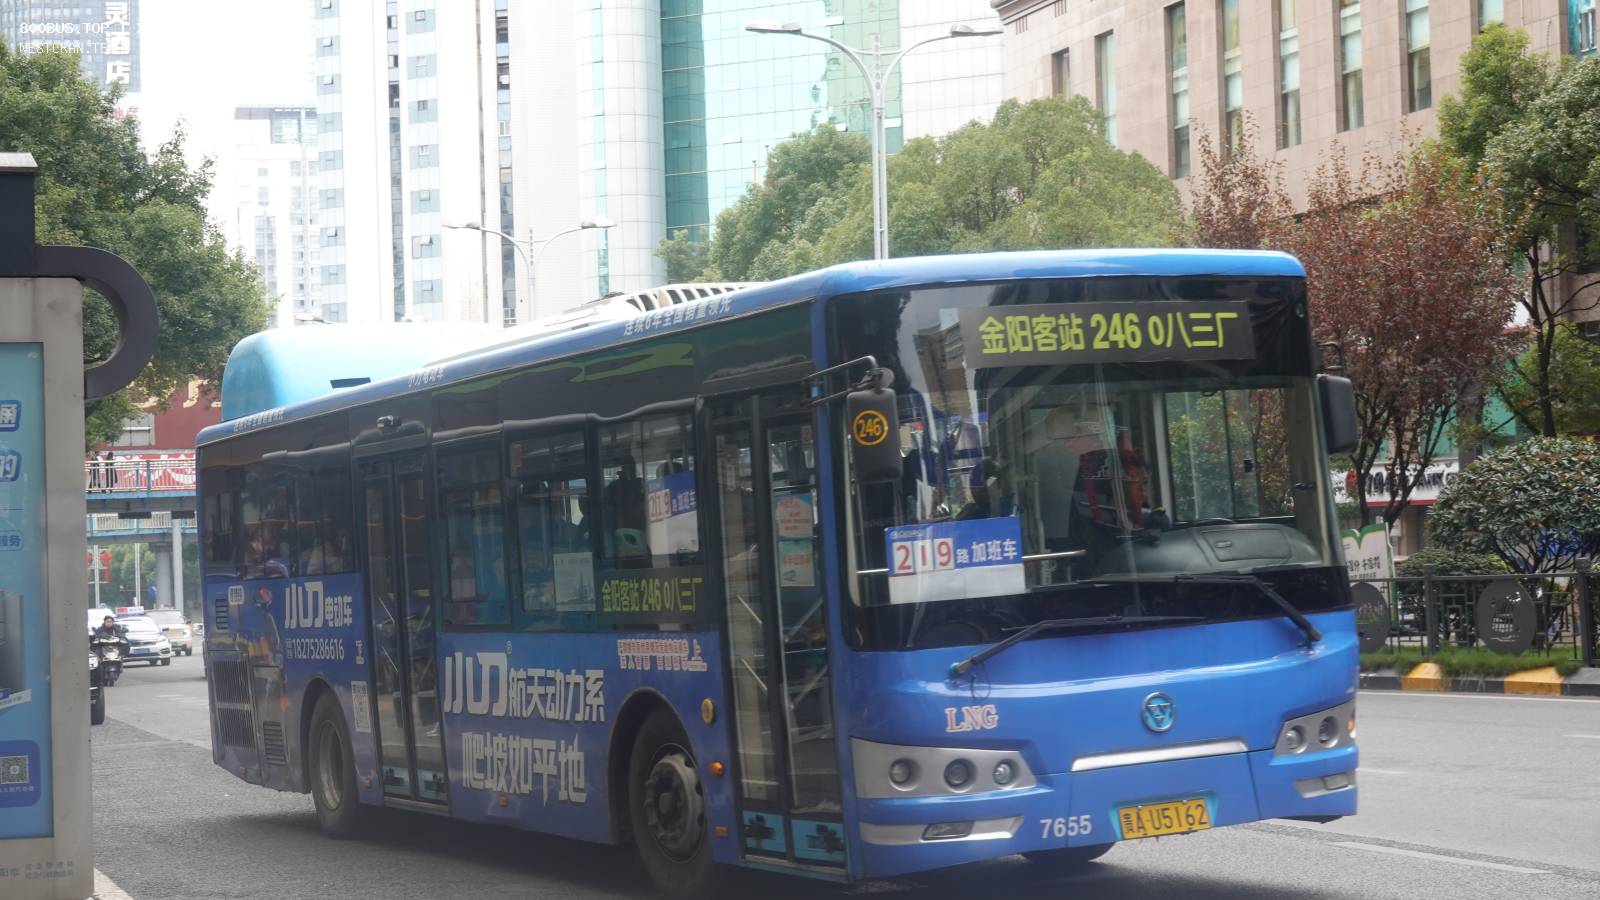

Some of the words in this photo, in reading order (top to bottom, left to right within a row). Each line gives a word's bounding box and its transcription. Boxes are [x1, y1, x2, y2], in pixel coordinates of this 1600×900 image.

[978, 314, 1086, 354] 金阳客站
[1090, 312, 1143, 350] 246
[856, 417, 882, 438] 246
[896, 541, 952, 570] 219
[602, 579, 640, 613] 金阳客站
[641, 578, 661, 612] 246
[293, 637, 345, 661] 18275286616
[945, 704, 999, 733] LNG
[461, 732, 587, 806] 爬坡如平地
[1039, 814, 1092, 839] 7655
